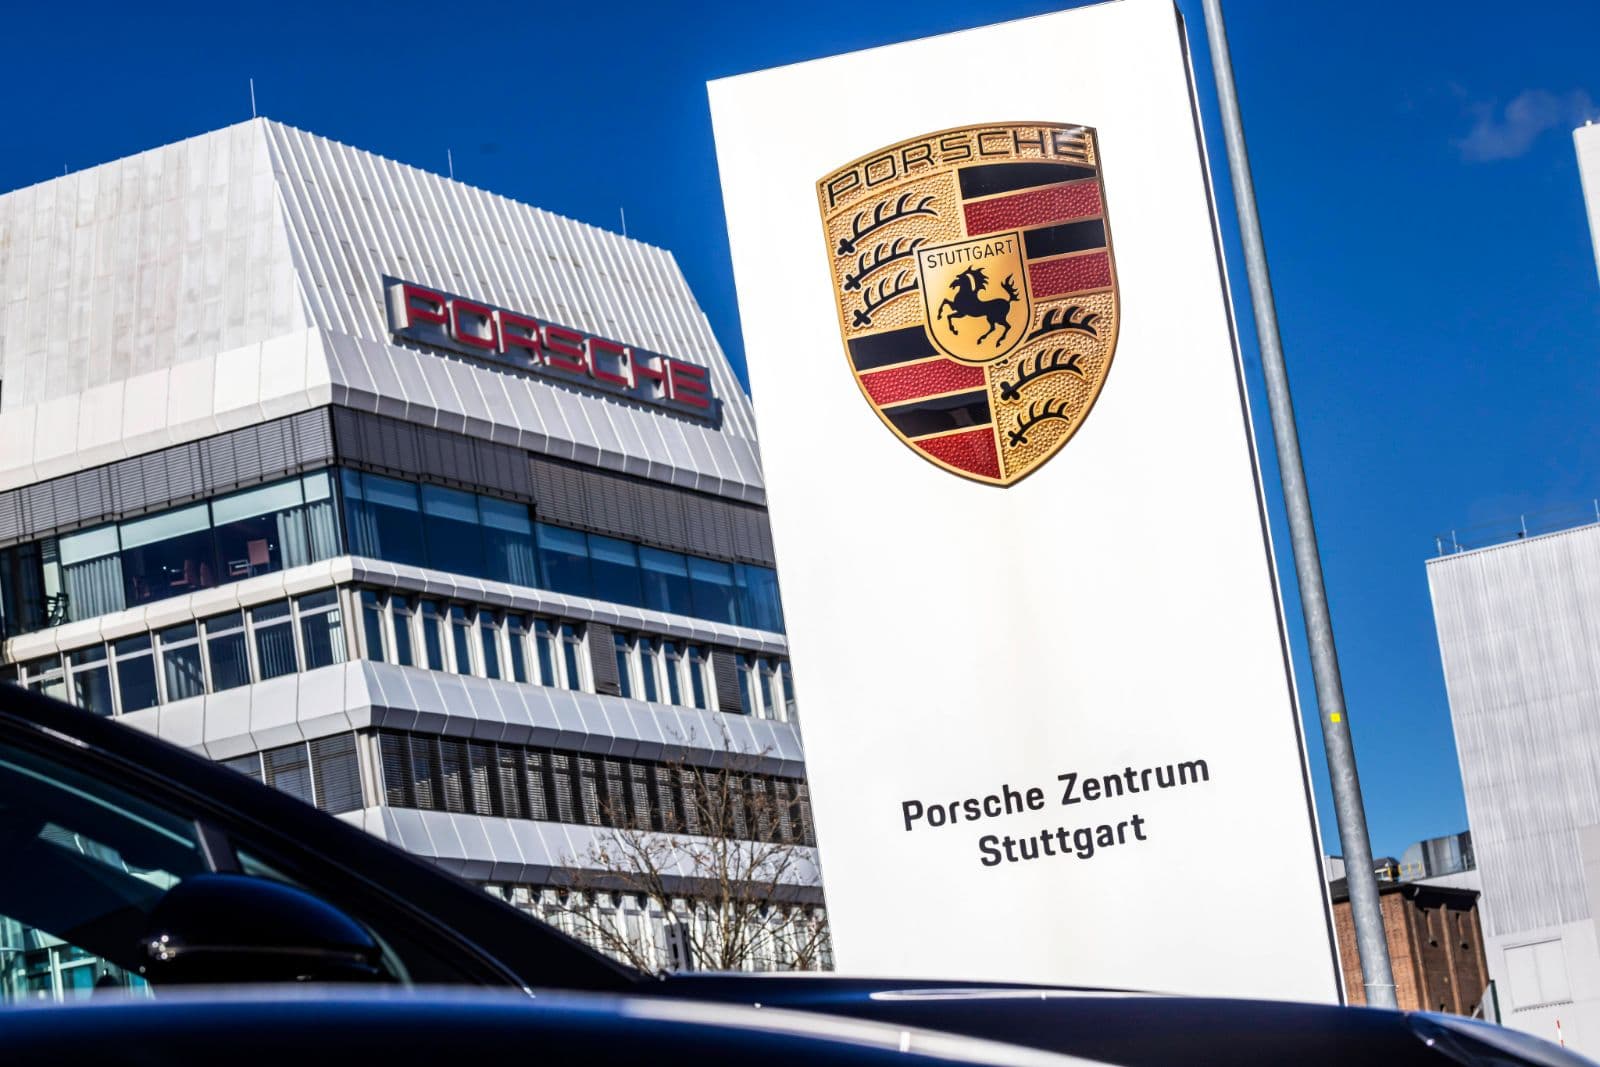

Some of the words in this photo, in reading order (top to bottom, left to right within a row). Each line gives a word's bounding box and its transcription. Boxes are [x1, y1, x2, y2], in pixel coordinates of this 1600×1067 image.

[826, 130, 1086, 208] PORSCHE
[927, 240, 1014, 269] STUTTGART
[401, 284, 710, 407] PORSCHE
[902, 784, 1045, 831] Porsche
[1058, 759, 1209, 805] Zentrum
[979, 814, 1147, 867] Stuttgart
